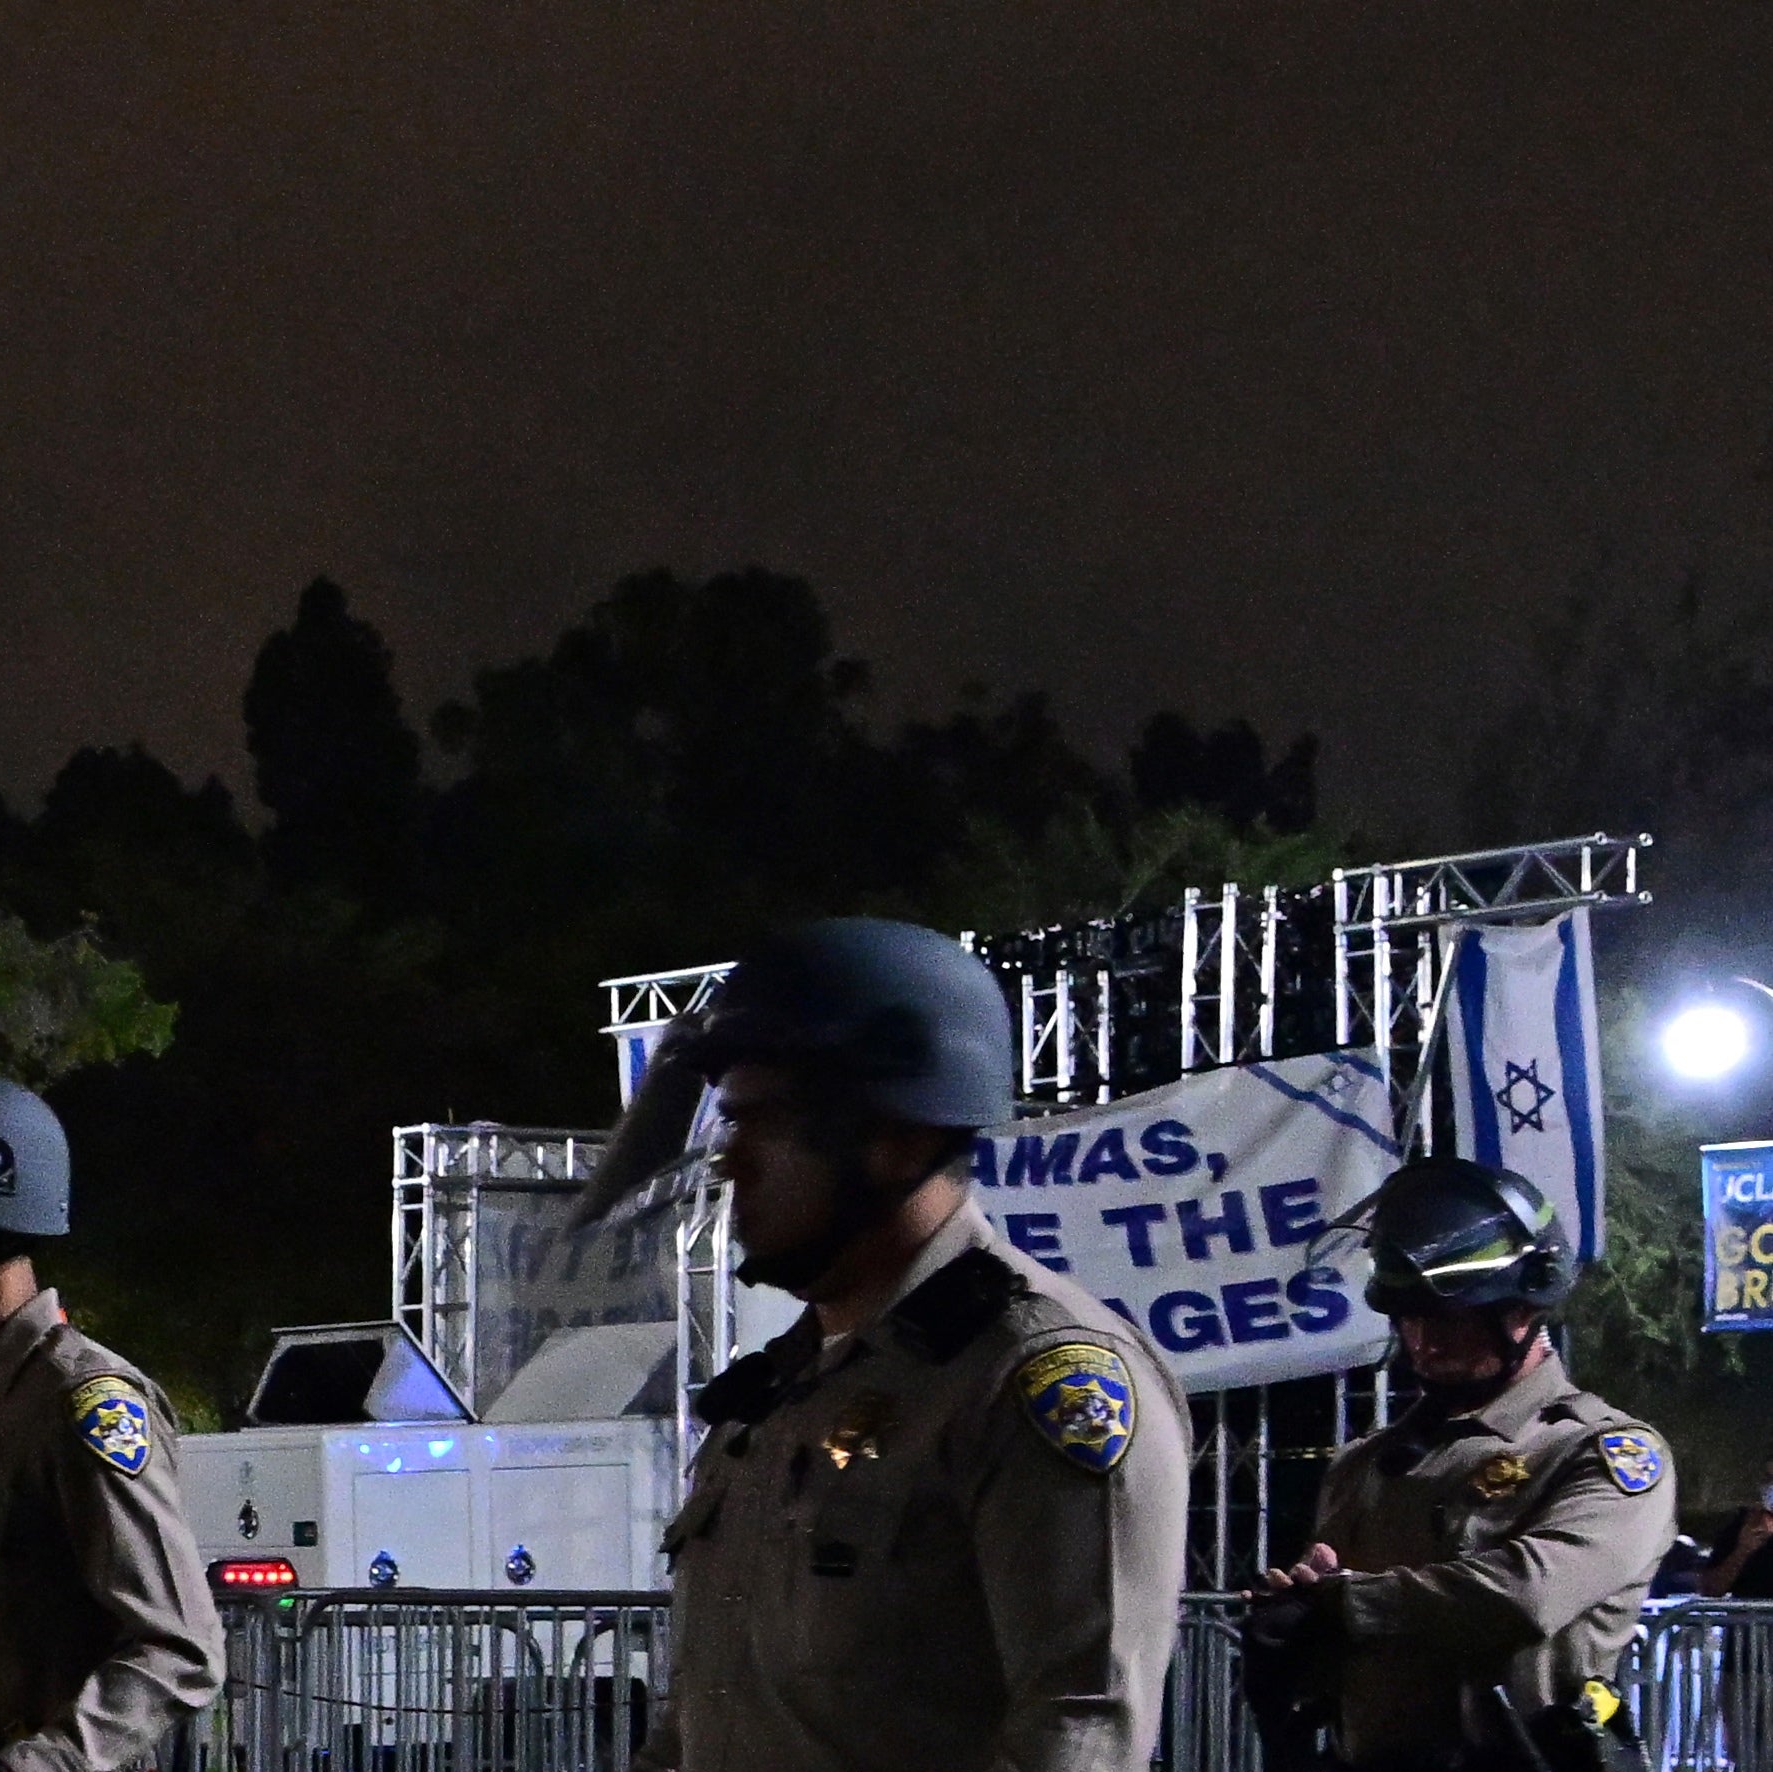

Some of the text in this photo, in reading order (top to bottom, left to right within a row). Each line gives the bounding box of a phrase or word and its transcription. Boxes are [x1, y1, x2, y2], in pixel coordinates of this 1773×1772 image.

[986, 1177, 1328, 1273] E THE
[1716, 1269, 1773, 1311] BR
